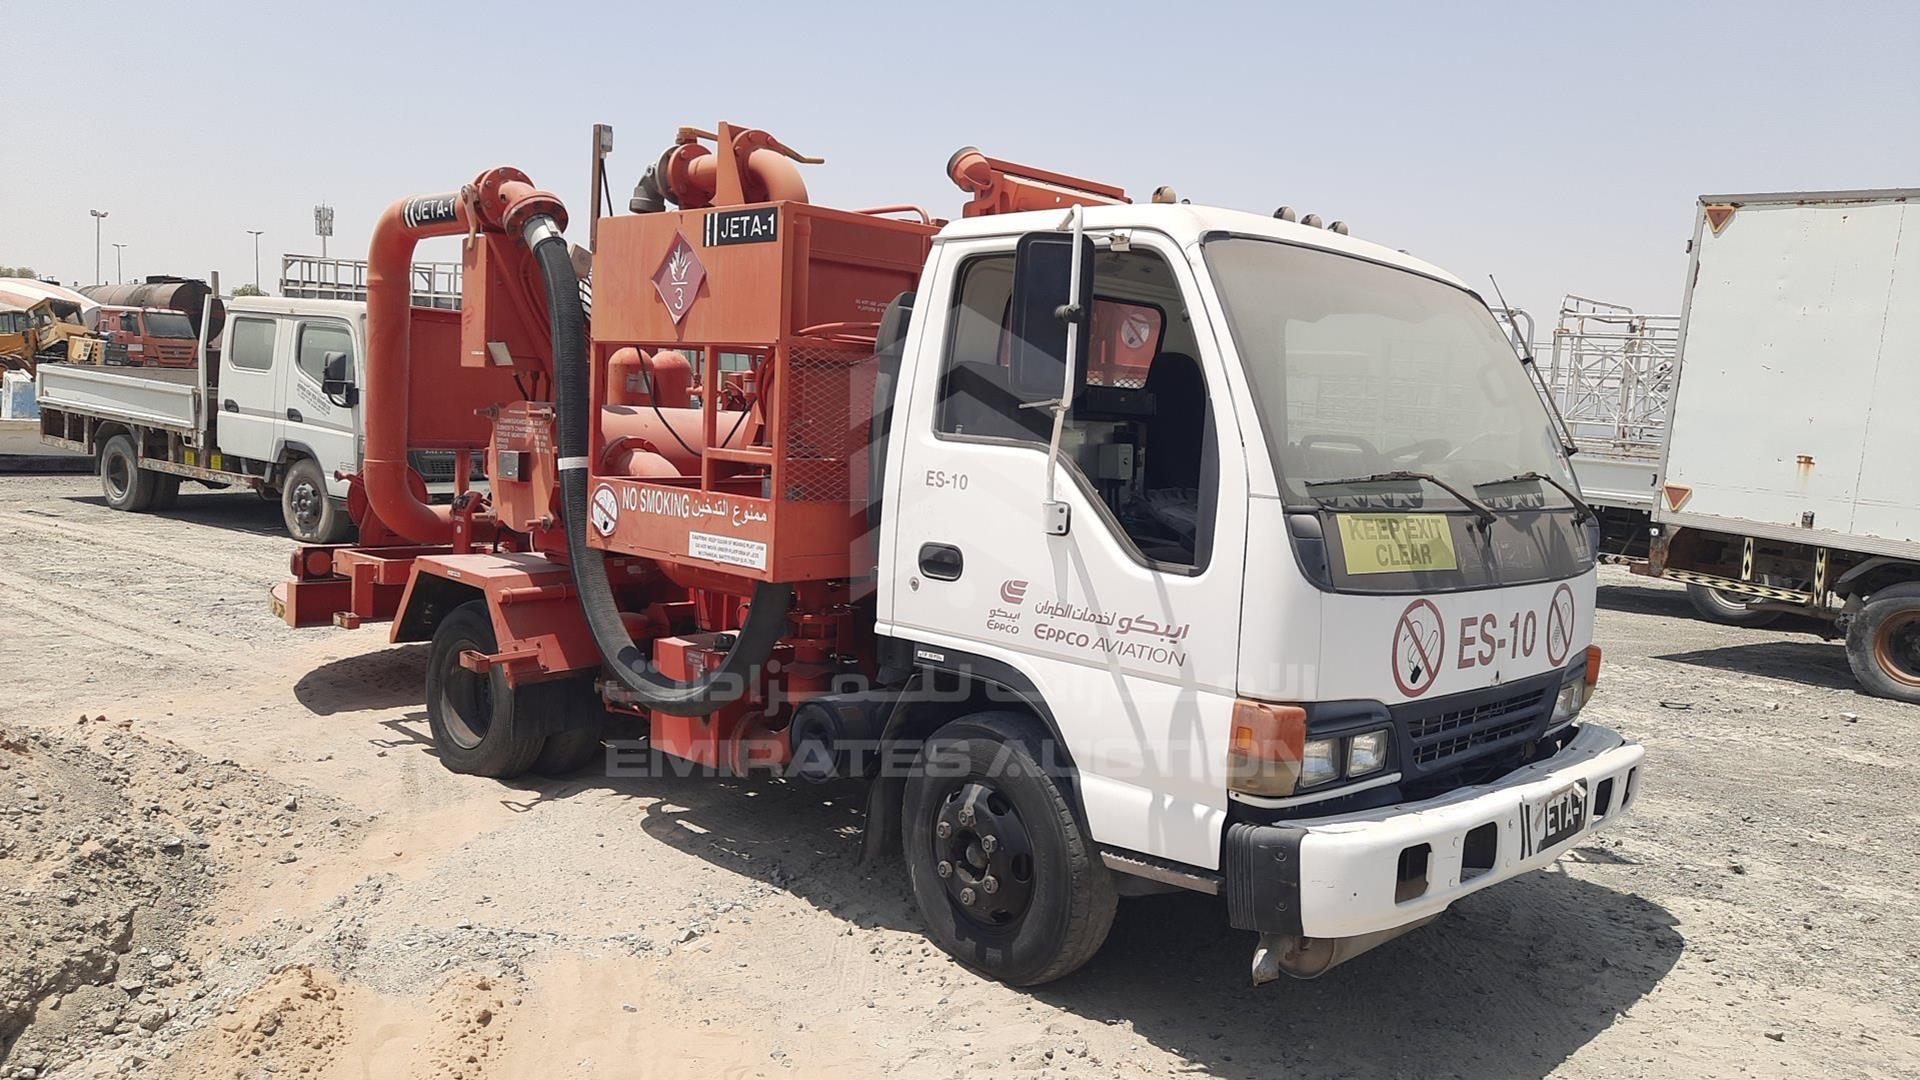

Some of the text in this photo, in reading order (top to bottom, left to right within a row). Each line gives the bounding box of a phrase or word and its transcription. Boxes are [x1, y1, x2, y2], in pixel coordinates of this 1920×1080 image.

[720, 213, 775, 238] JETA-1
[674, 287, 684, 310] 3
[926, 470, 969, 490] ES-10
[622, 486, 690, 518] NO SMOKING
[691, 498, 768, 527] ممنوع التدخين
[1347, 517, 1442, 541] KEEP EXIT
[1376, 543, 1433, 567] CLEAR
[1034, 600, 1073, 619] الطيران
[1092, 636, 1187, 667] AVIATION
[1457, 610, 1537, 669] ES-10
